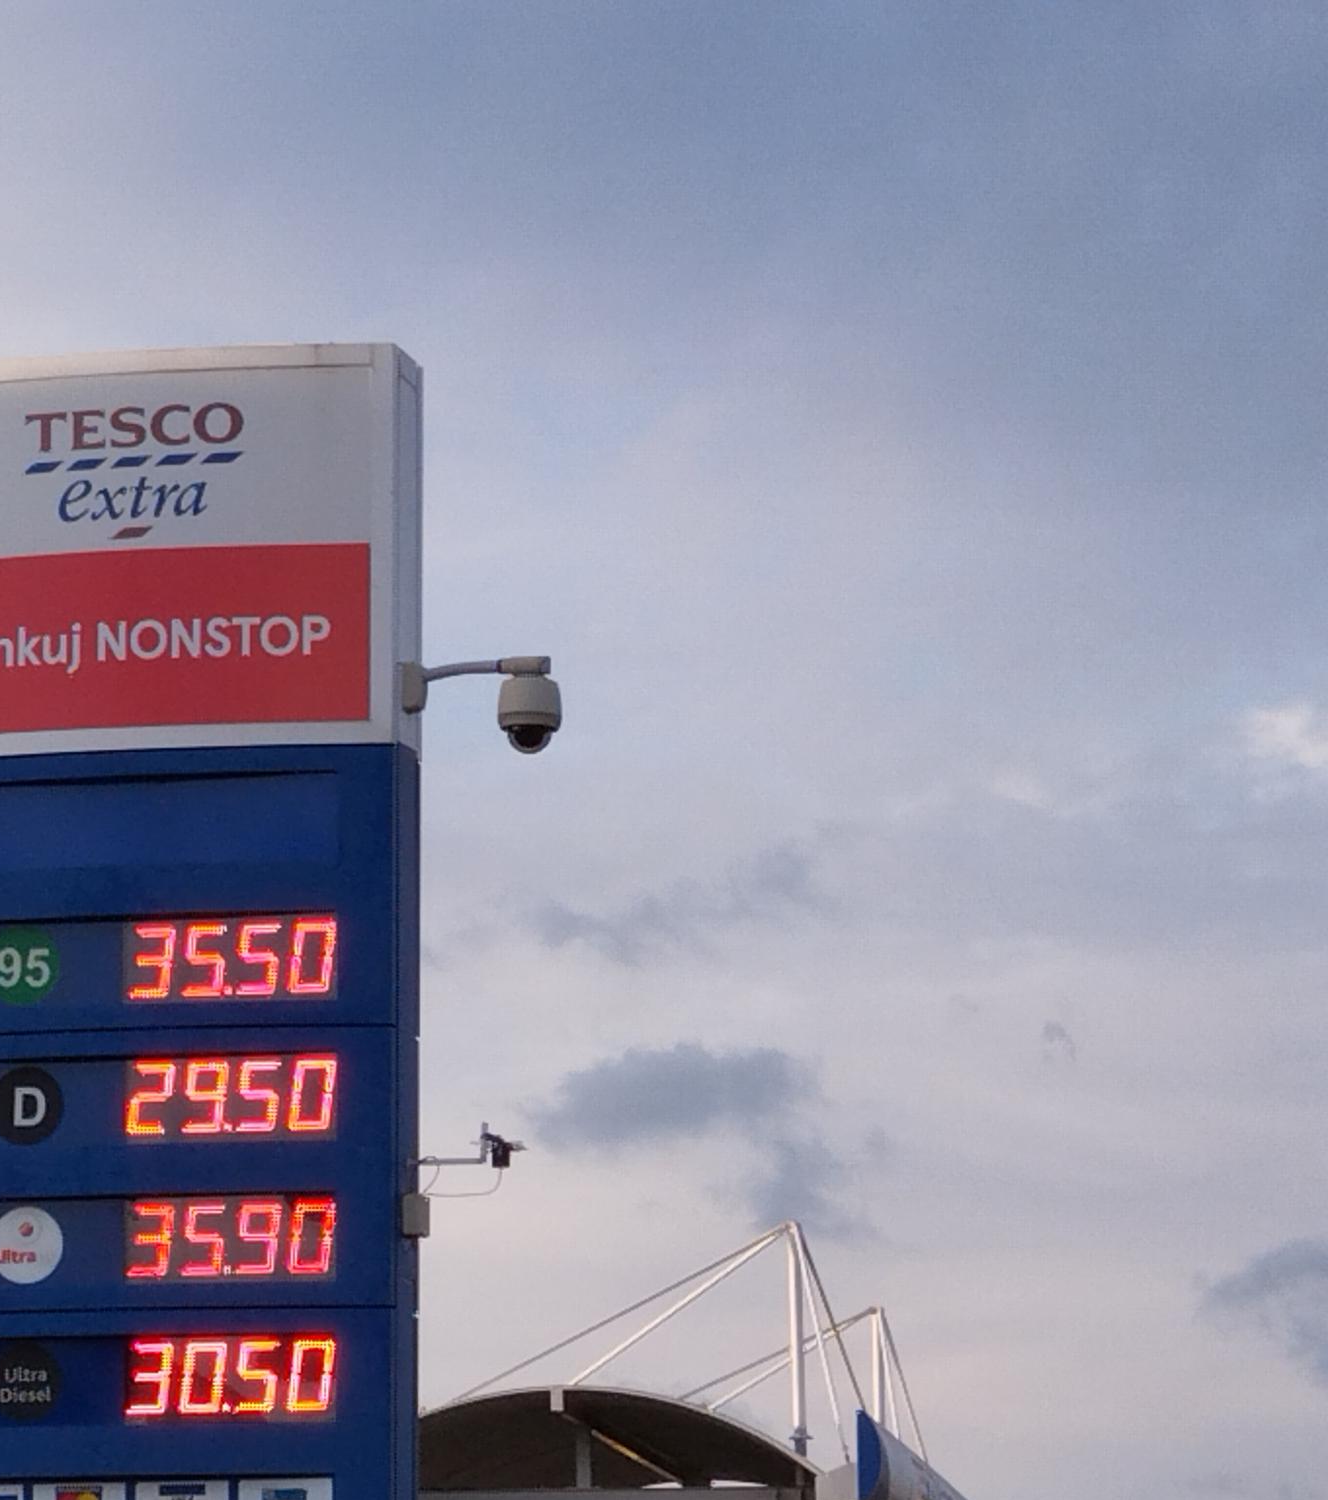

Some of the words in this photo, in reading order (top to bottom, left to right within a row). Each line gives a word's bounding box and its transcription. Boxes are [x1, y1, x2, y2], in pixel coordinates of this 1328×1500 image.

[25, 402, 244, 453] TESCO
[58, 475, 208, 522] extra
[96, 615, 331, 662] NONSTOP
[127, 917, 337, 999] 35.50
[12, 1086, 47, 1128] D
[125, 1059, 337, 1136] 29.50
[125, 1201, 337, 1278] 35.90
[0, 1386, 51, 1403] Diesel
[4, 1367, 48, 1384] Ultra
[125, 1340, 337, 1416] 30.50
